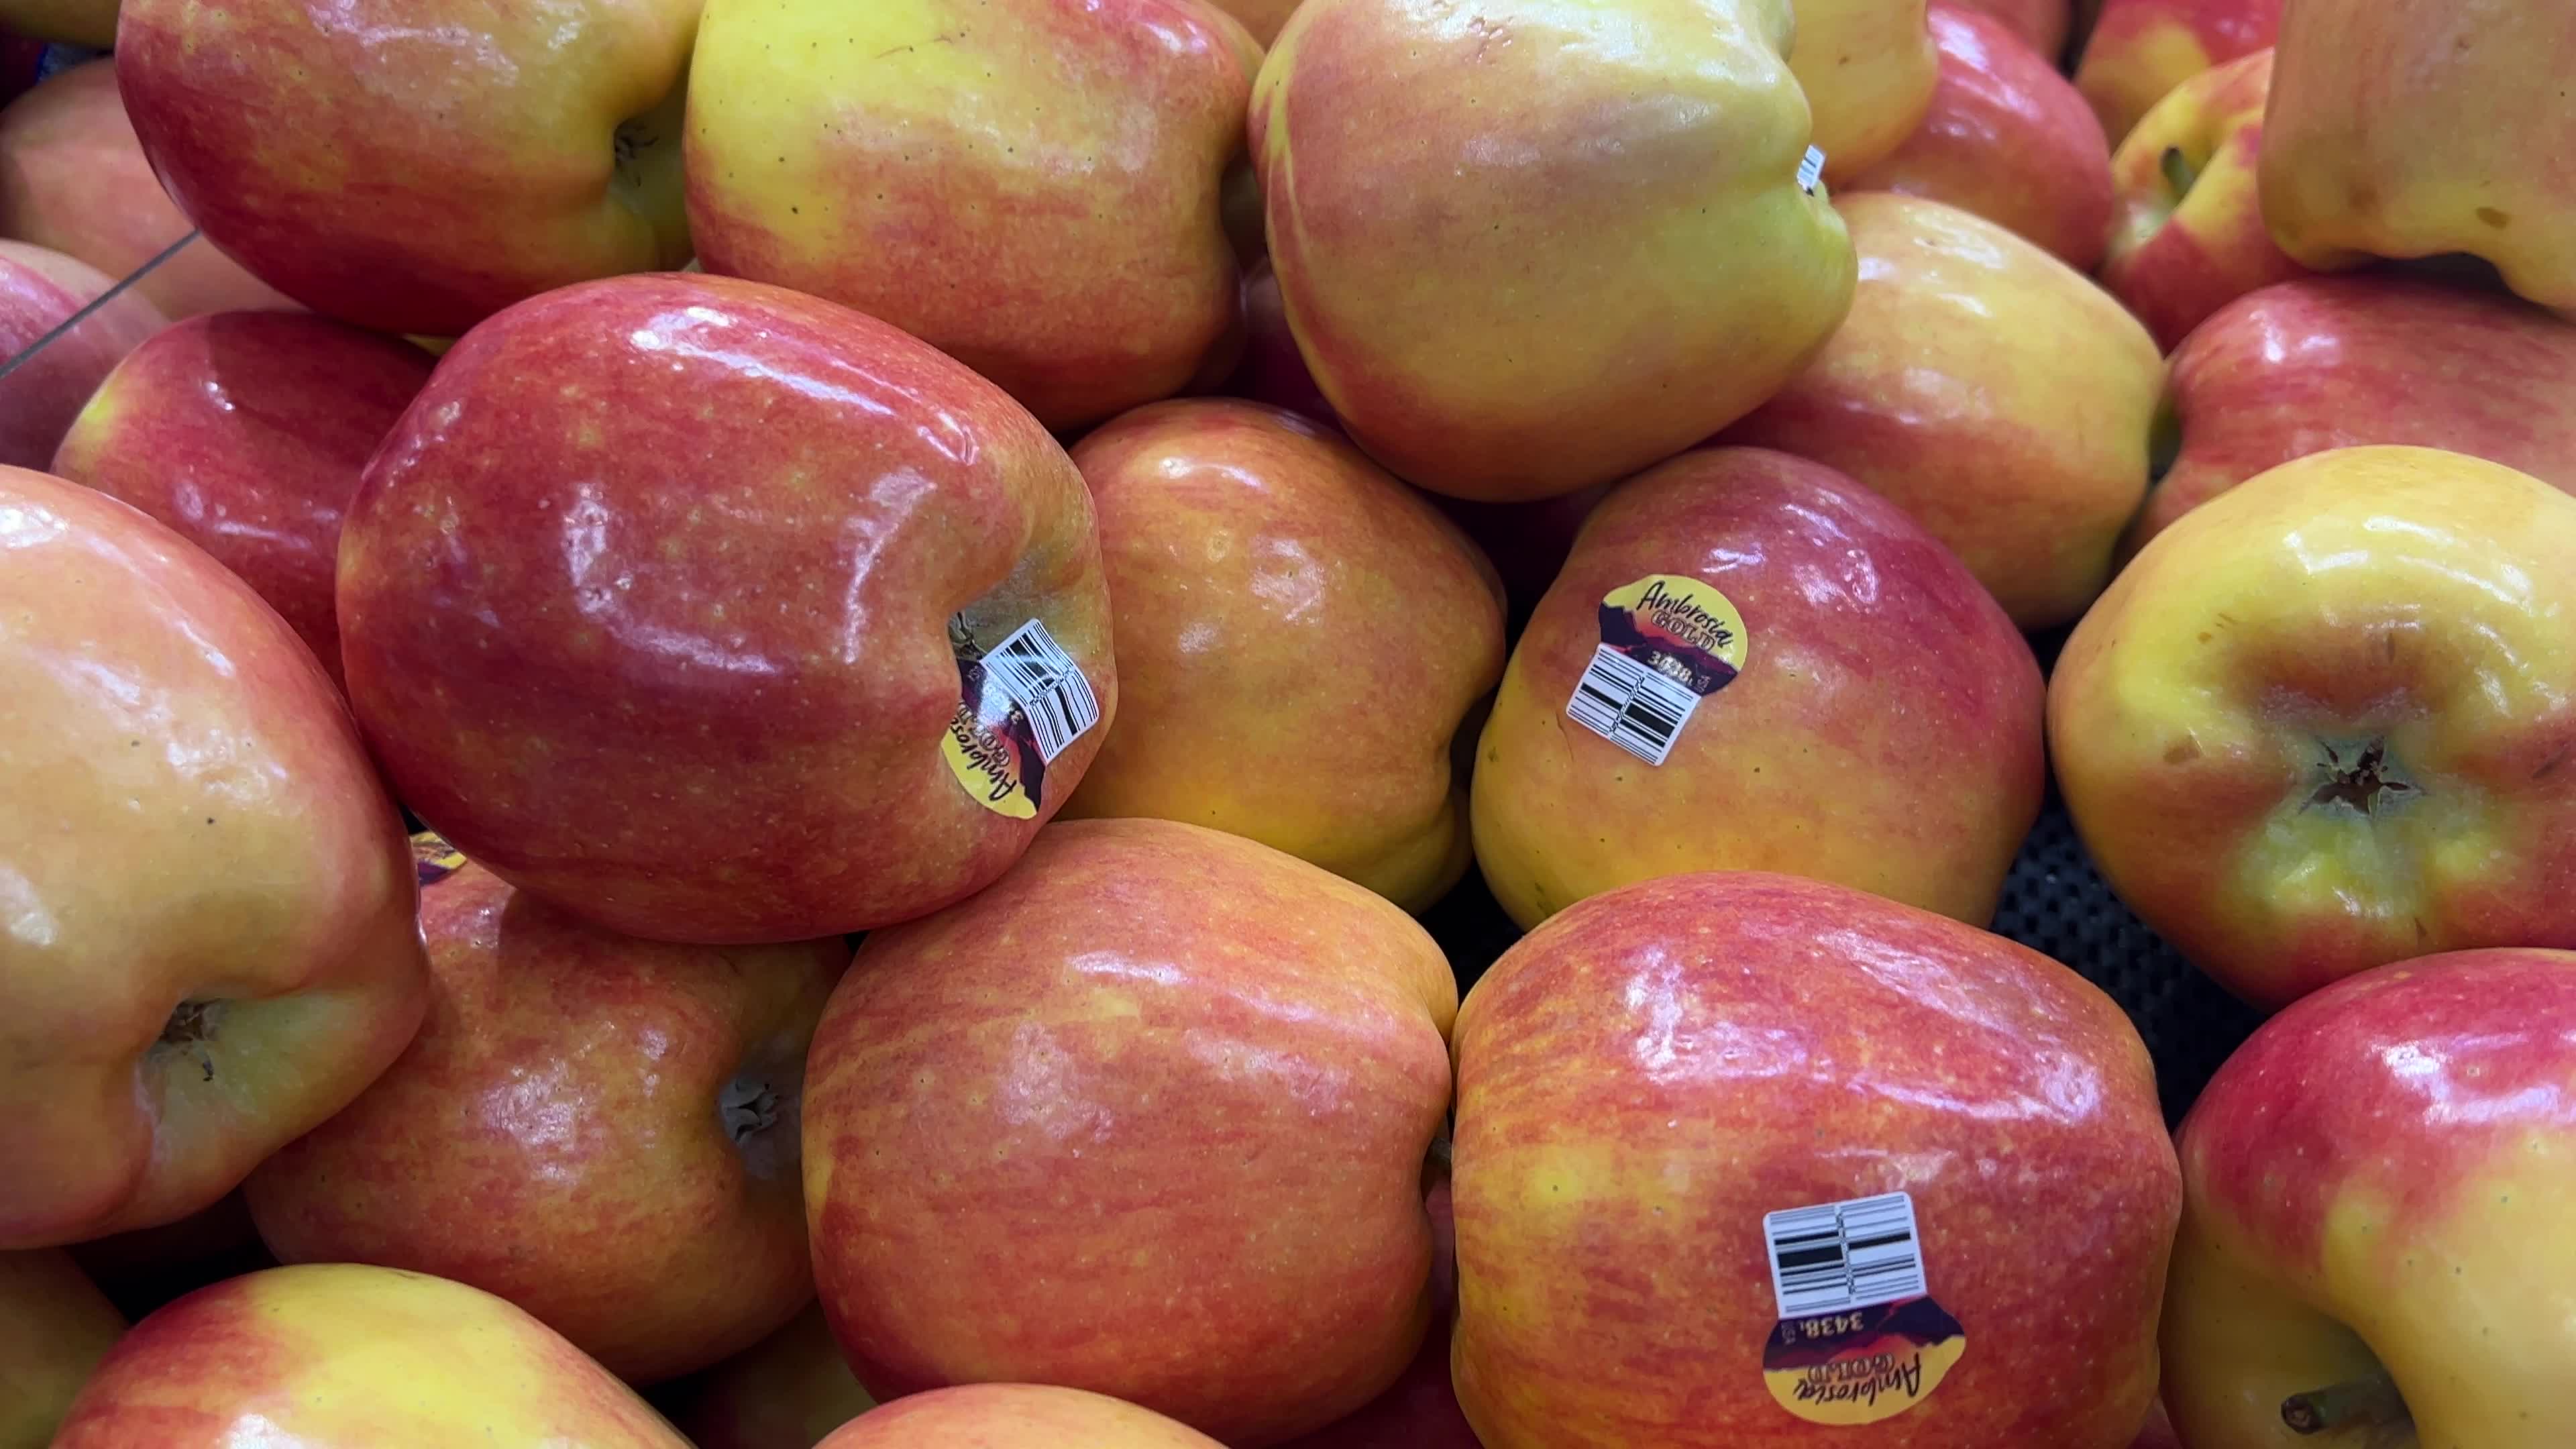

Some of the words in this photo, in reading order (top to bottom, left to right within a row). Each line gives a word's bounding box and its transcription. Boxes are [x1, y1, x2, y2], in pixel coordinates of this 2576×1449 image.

[1635, 580, 1735, 648] Ambrosia
[1650, 610, 1716, 651] GOLD
[949, 716, 1017, 801] Ambrosi
[1792, 1352, 1922, 1407] Ambrosia
[1806, 1353, 1896, 1384] GOLD
